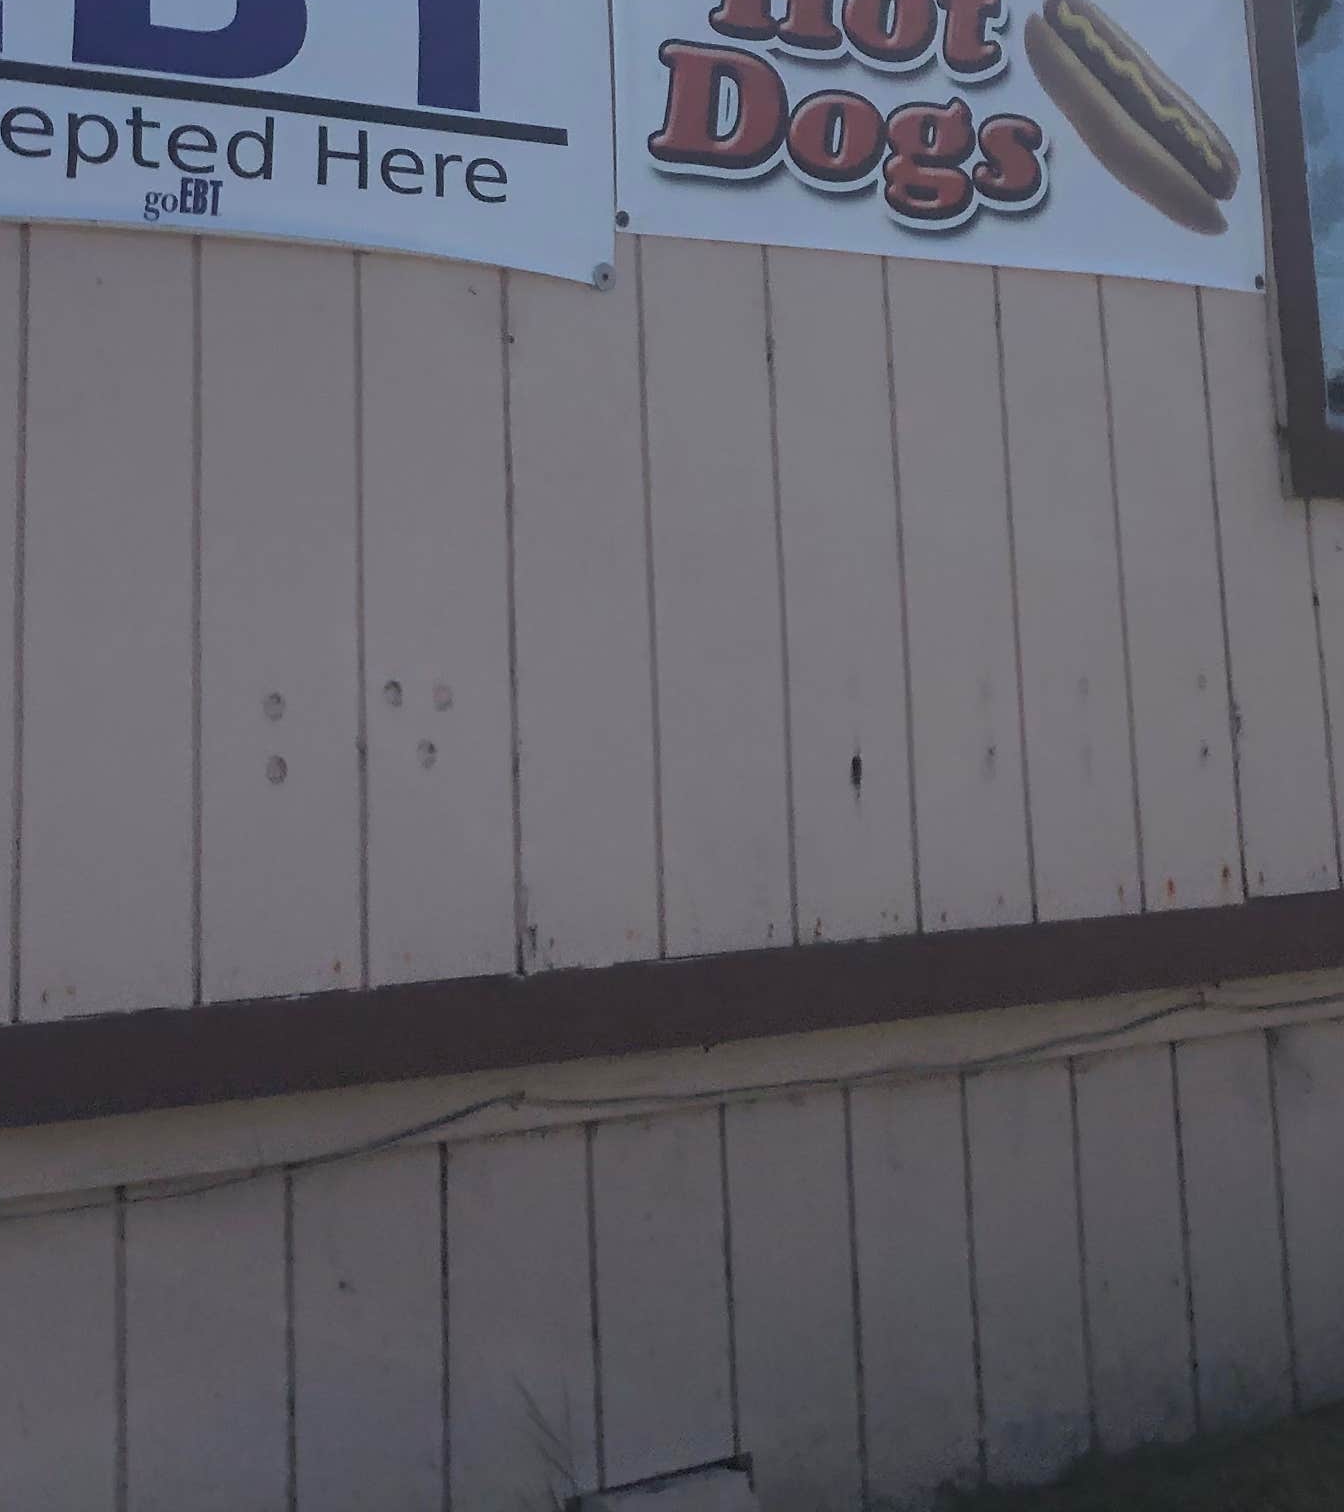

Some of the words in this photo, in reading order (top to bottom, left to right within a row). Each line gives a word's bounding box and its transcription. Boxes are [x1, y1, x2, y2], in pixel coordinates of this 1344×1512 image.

[316, 124, 509, 204] Here
[647, 38, 1048, 220] Dogs
[143, 176, 224, 222] goEBT
